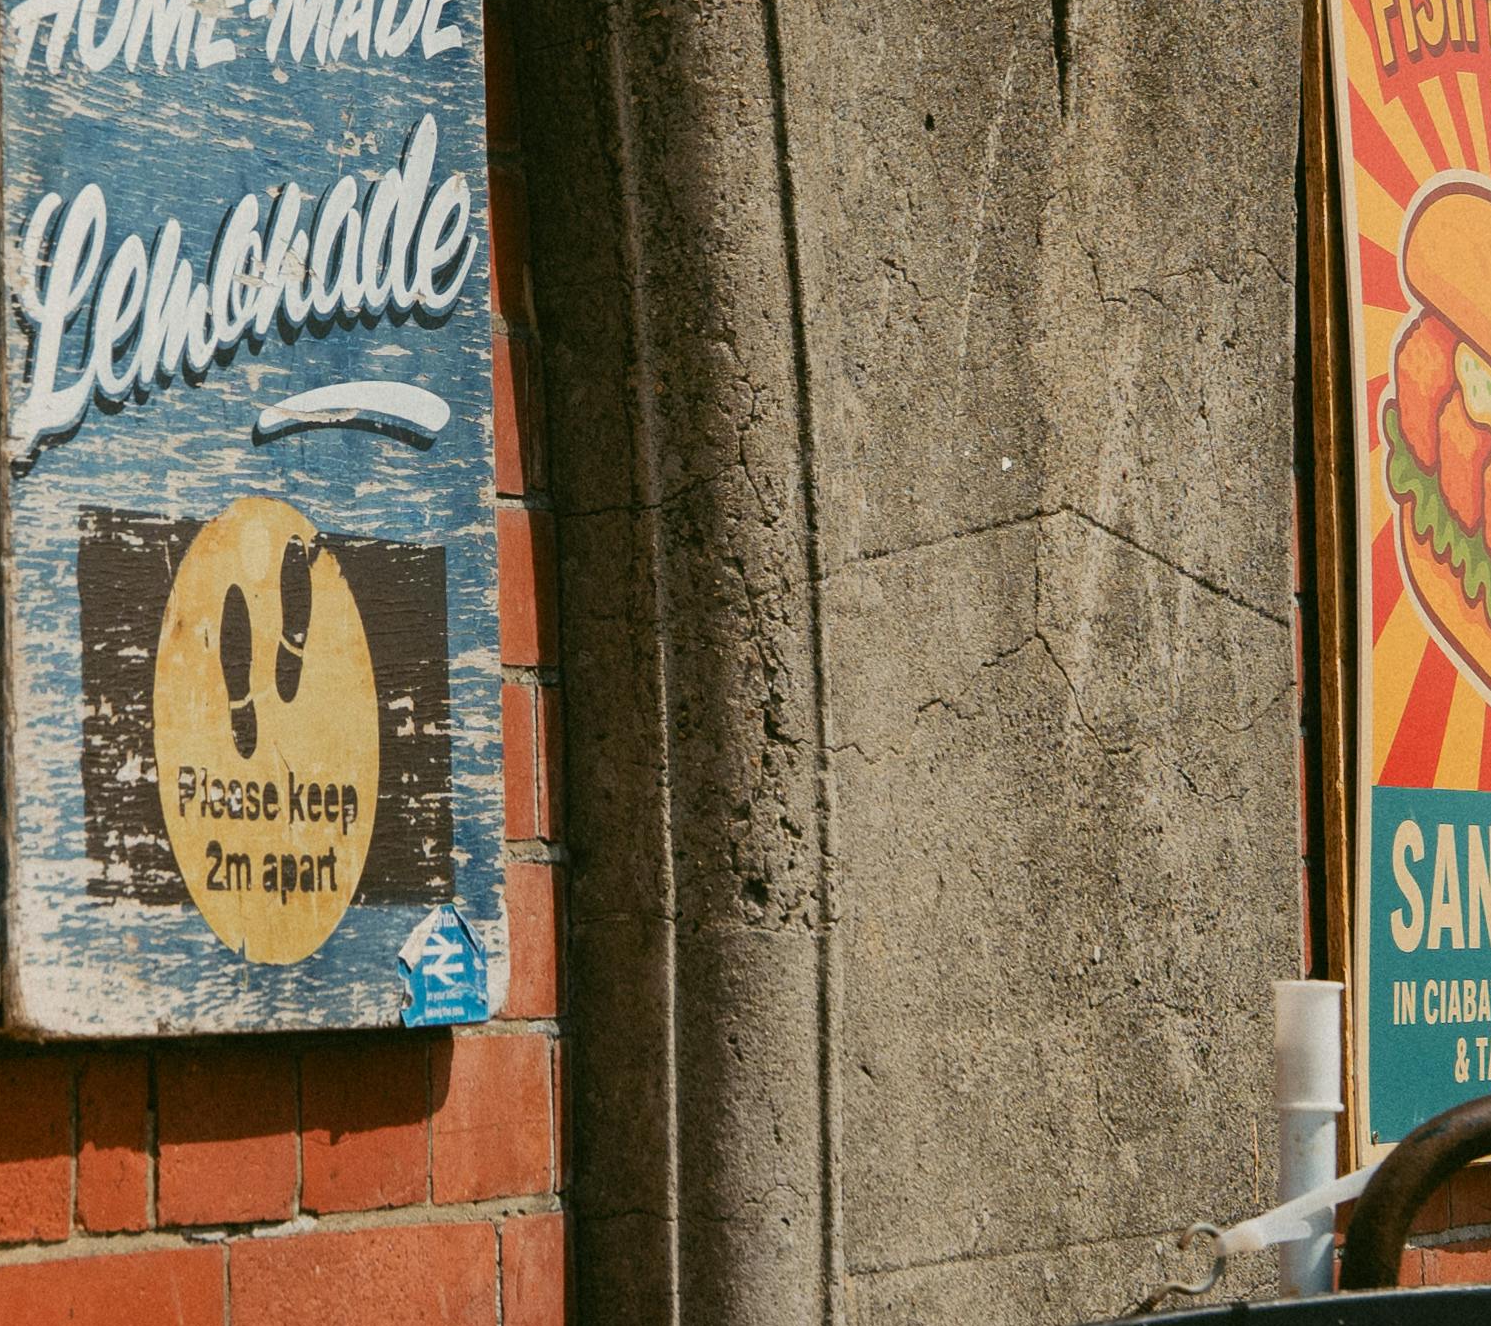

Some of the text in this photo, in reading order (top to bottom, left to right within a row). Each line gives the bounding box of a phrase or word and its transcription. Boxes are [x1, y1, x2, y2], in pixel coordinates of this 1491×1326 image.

[13, 112, 480, 467] Lemonade
[178, 766, 359, 836] Please keep
[206, 840, 338, 906] 2m apart
[1393, 981, 1416, 1025] IN
[1454, 1037, 1470, 1083] &
